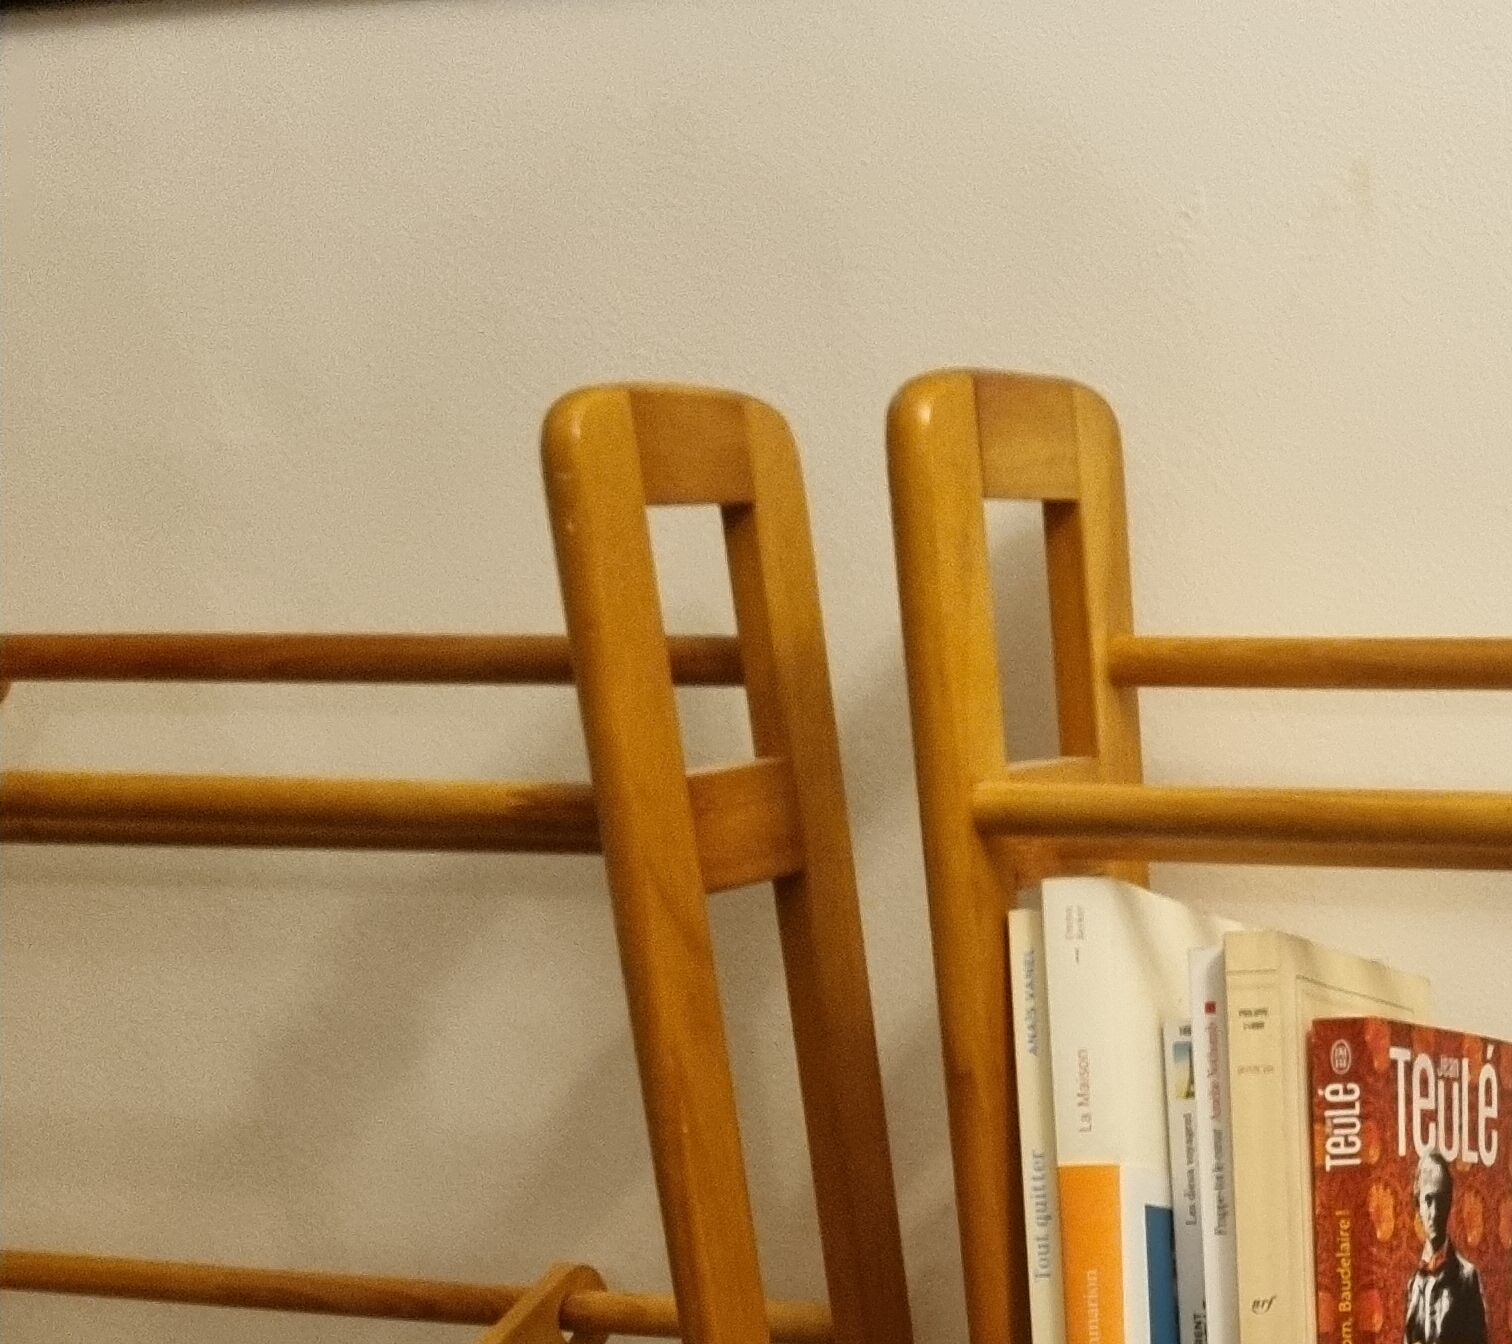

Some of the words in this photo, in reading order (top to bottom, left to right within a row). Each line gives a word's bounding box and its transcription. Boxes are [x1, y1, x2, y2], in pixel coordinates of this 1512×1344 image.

[1077, 1047, 1091, 1108] Maison
[1079, 1115, 1093, 1133] La
[1030, 1150, 1053, 1229] quitter
[1032, 1233, 1051, 1285] Tout
[1251, 1295, 1278, 1315] nrf
